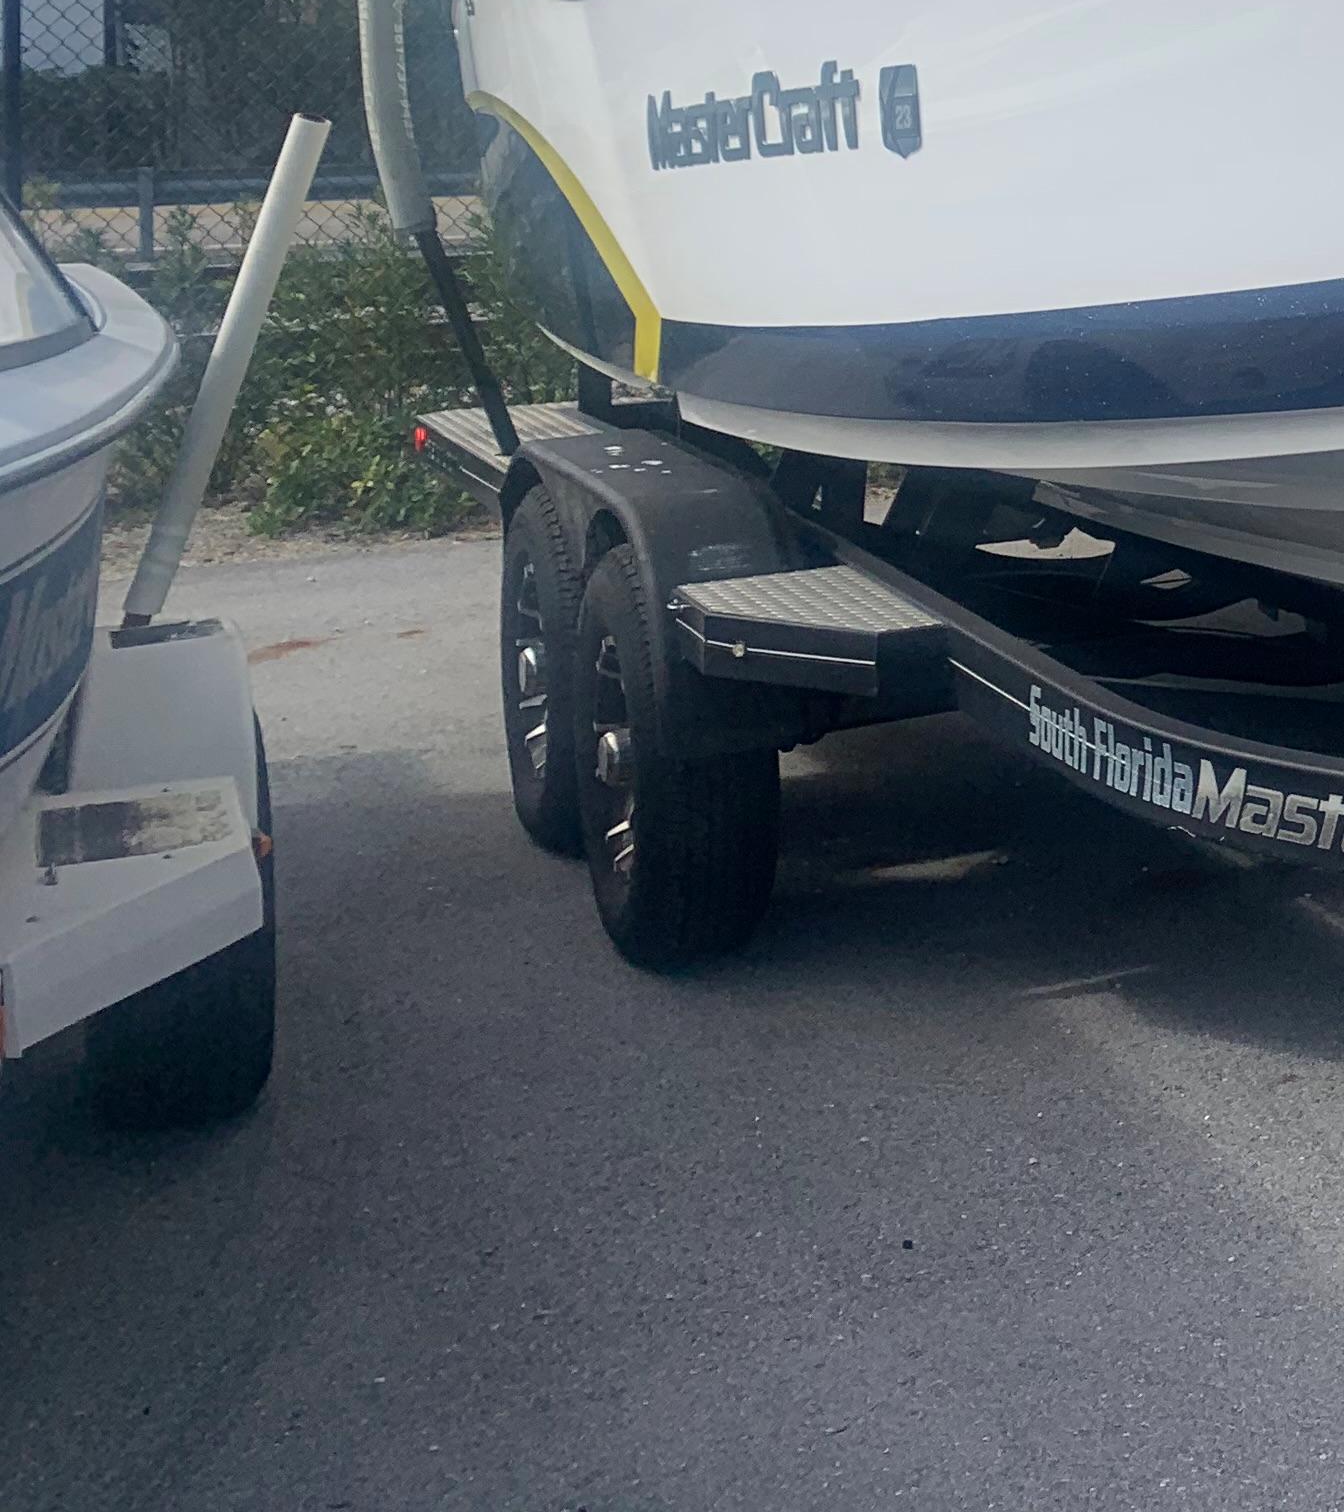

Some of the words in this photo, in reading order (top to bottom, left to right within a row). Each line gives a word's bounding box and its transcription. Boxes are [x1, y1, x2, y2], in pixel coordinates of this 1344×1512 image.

[648, 61, 860, 171] MasterCraft
[895, 104, 912, 130] 23
[1029, 685, 1087, 774] South
[1093, 717, 1192, 814] Florida
